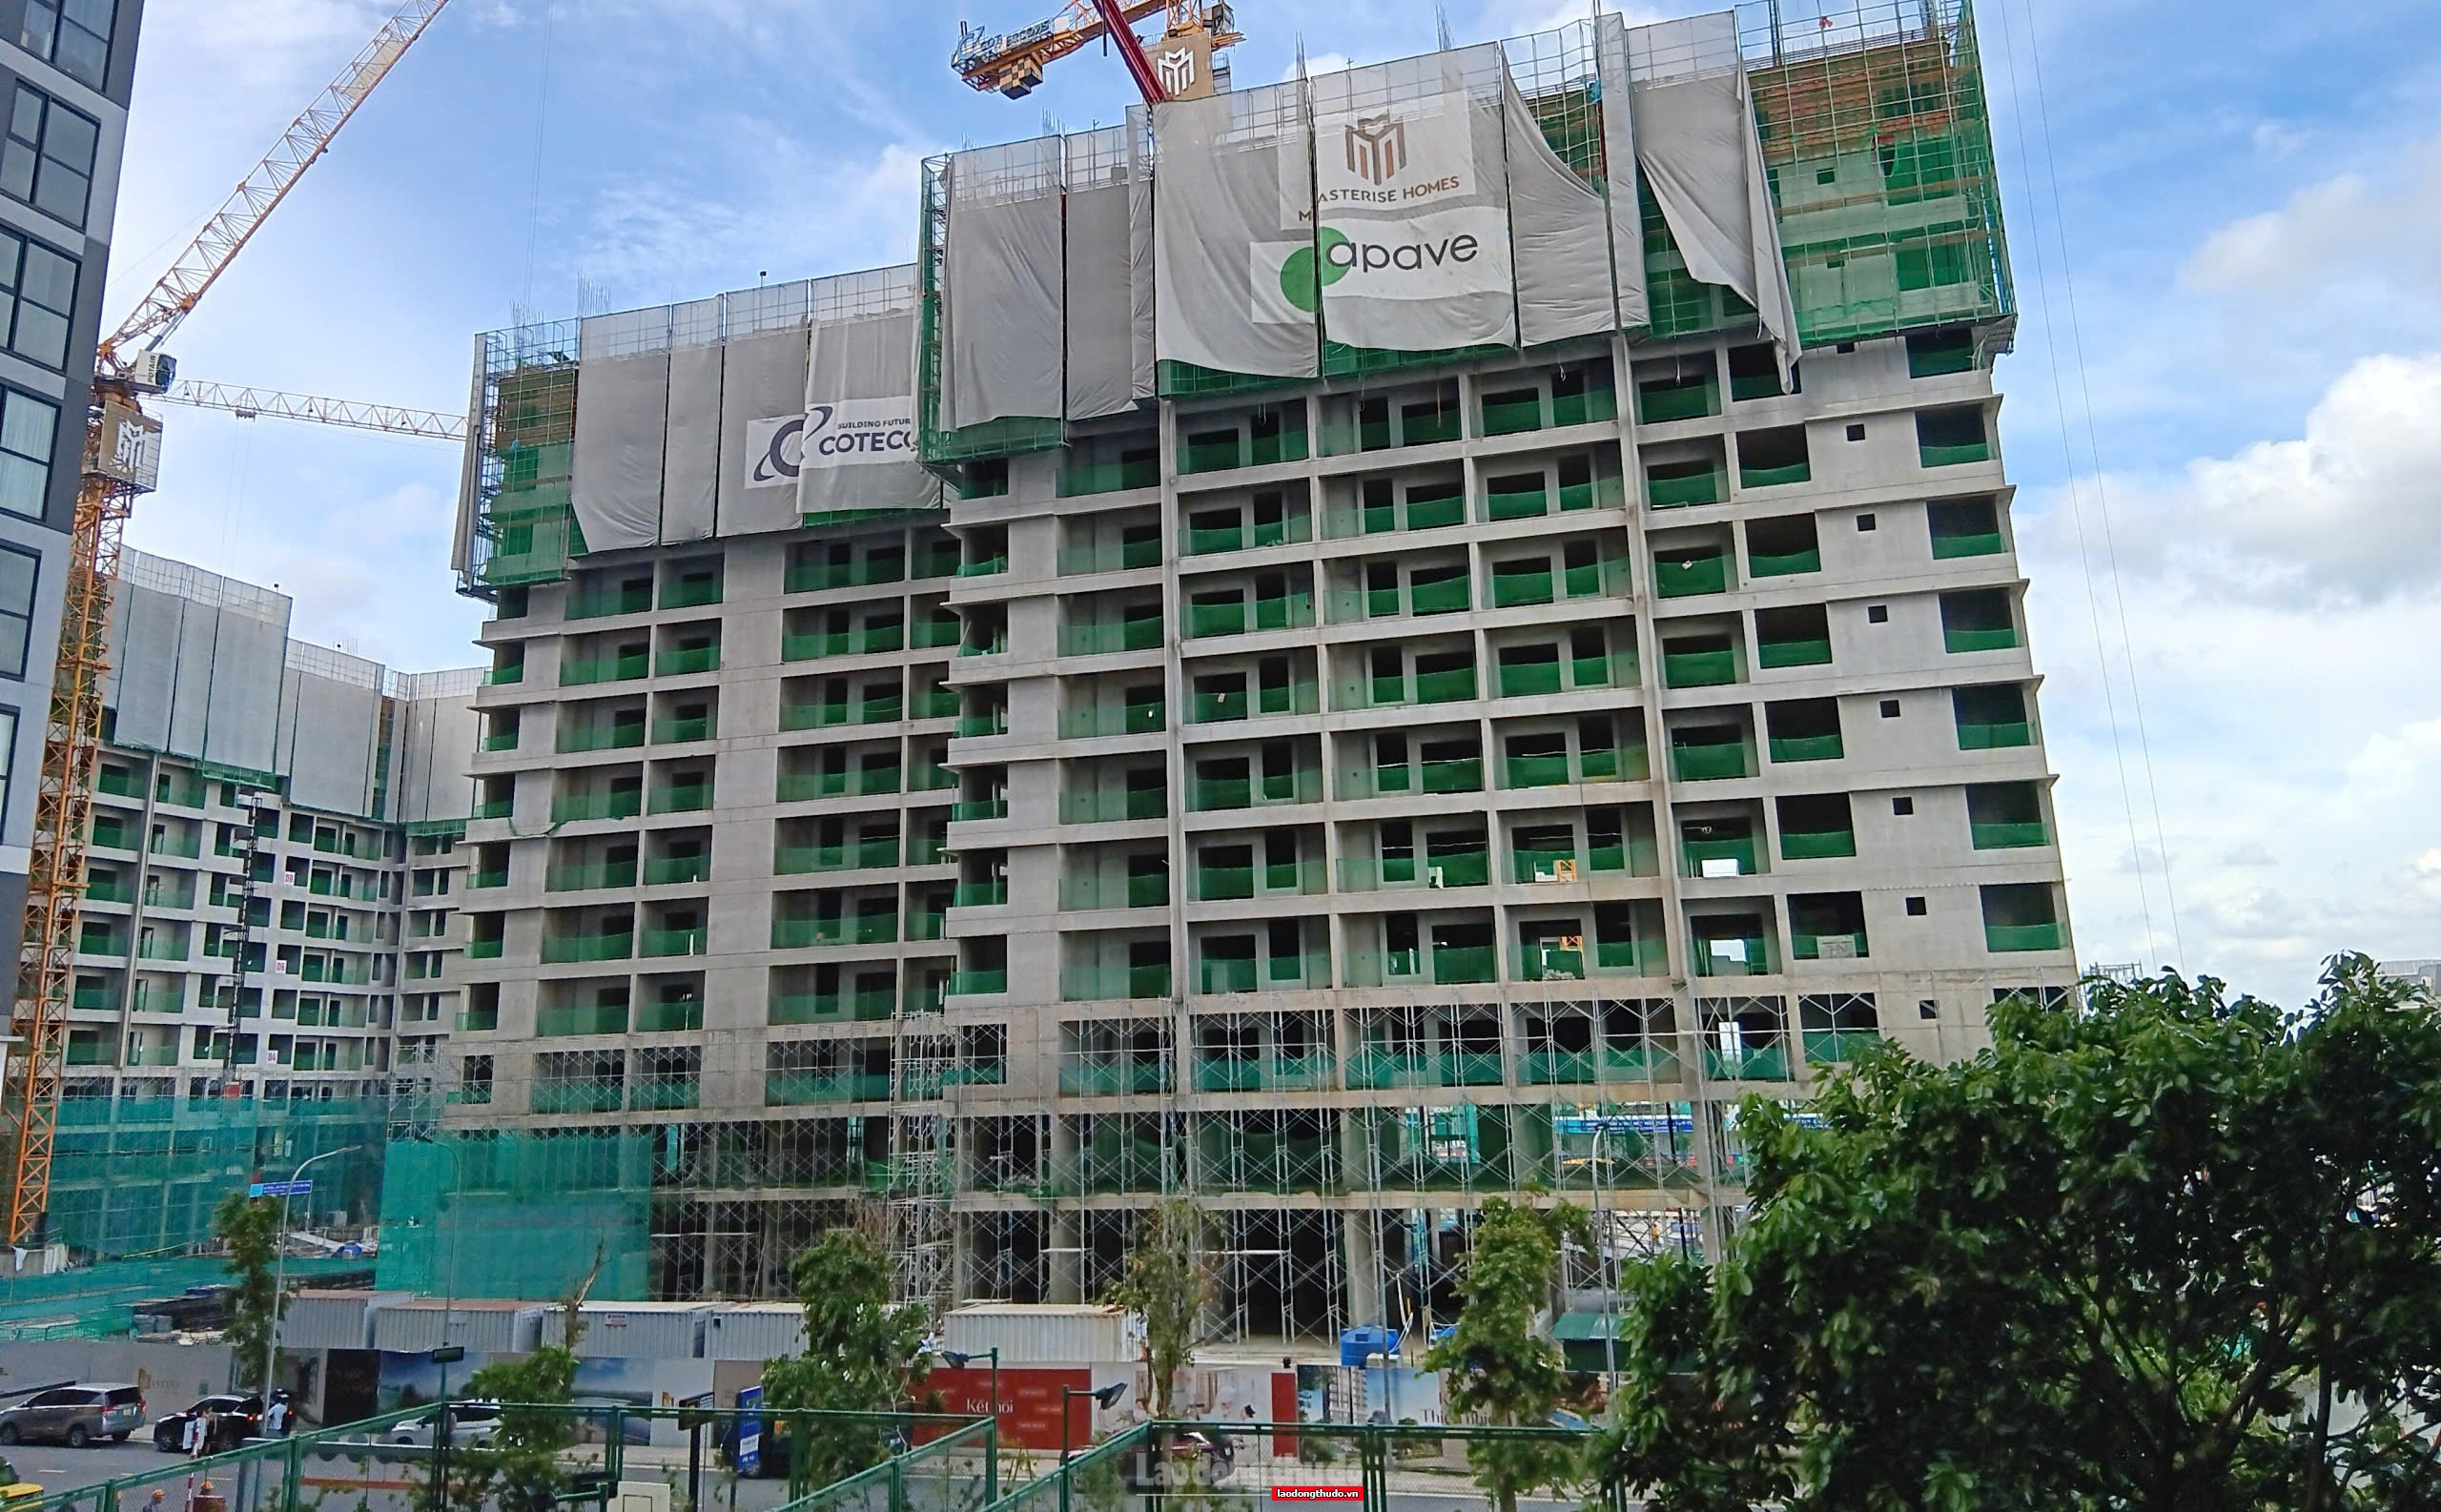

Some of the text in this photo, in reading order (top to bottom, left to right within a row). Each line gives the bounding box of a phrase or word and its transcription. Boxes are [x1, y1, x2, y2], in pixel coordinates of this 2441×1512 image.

[1403, 176, 1460, 200] HOMES
[1326, 235, 1478, 273] apave
[837, 420, 881, 430] BUILDING
[966, 1397, 990, 1414] Kết
